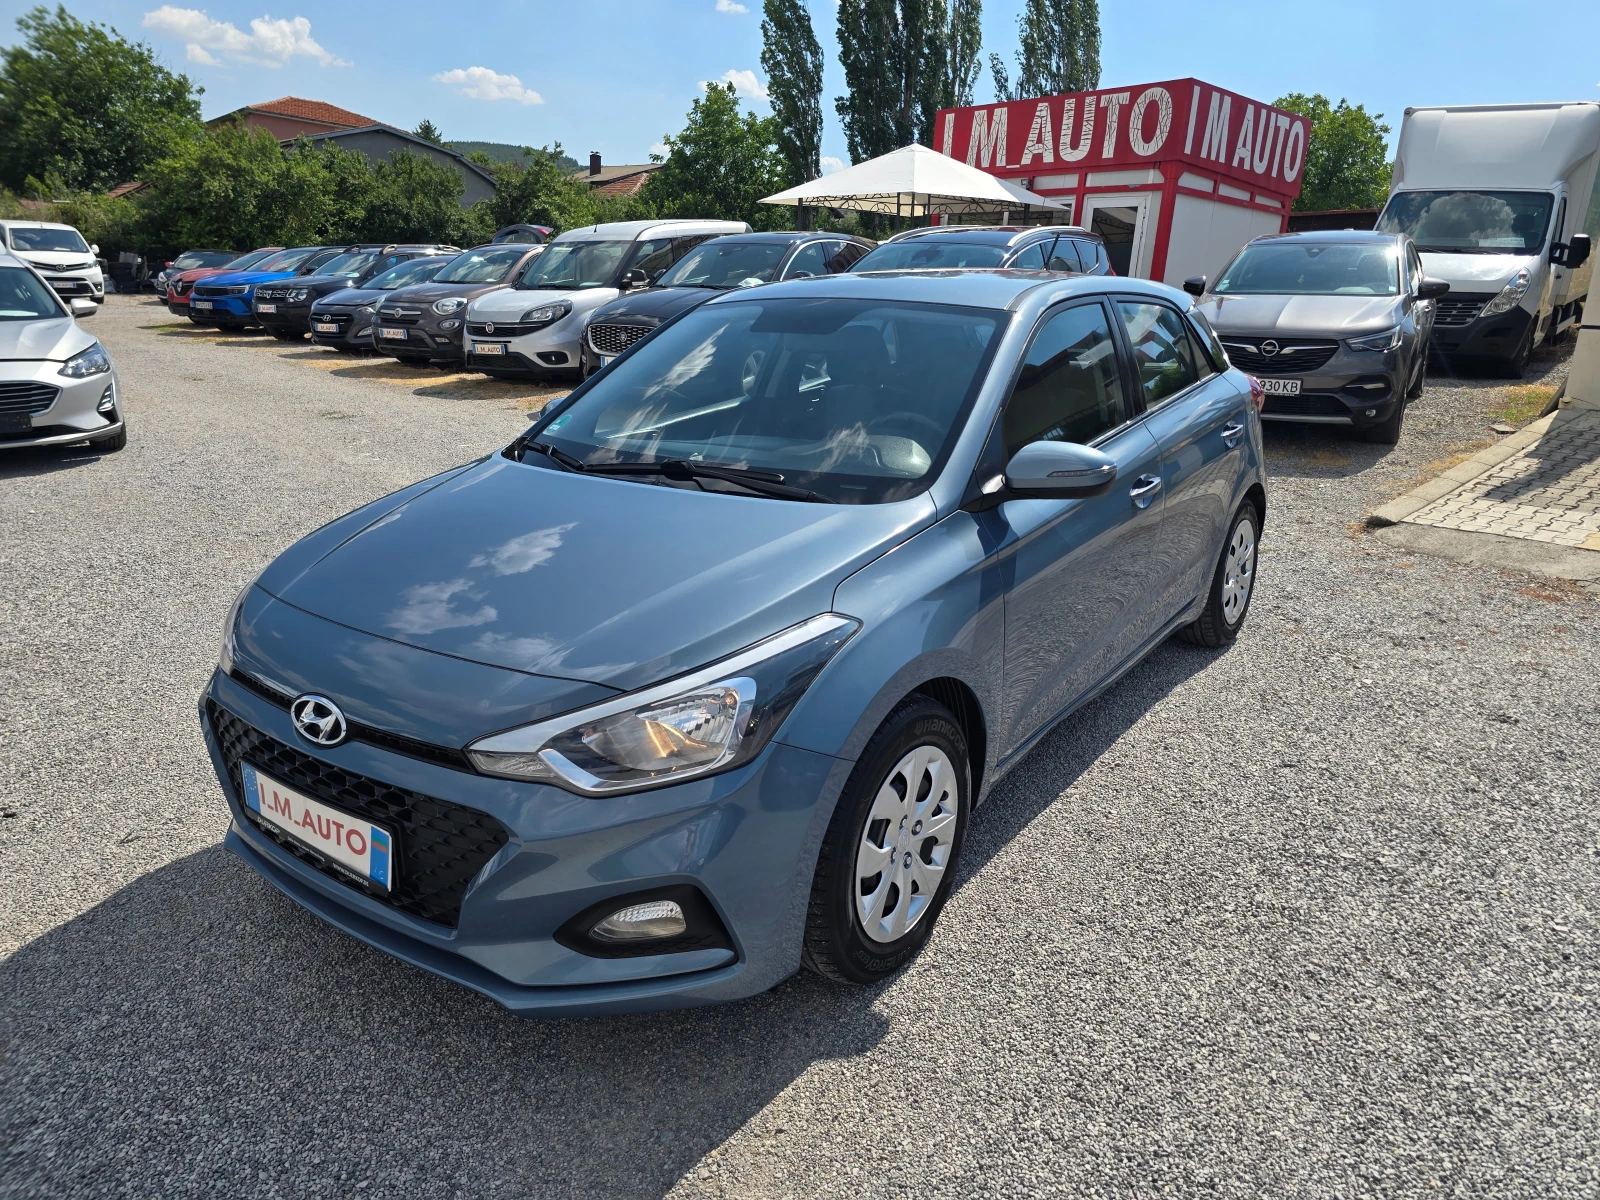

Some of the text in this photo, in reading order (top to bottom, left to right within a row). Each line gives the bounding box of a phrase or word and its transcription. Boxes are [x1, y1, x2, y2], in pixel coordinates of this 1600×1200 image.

[1184, 85, 1201, 155] I
[1232, 103, 1305, 183] AUTO
[1282, 381, 1298, 393] KB
[260, 783, 368, 857] I_M_AUTO
